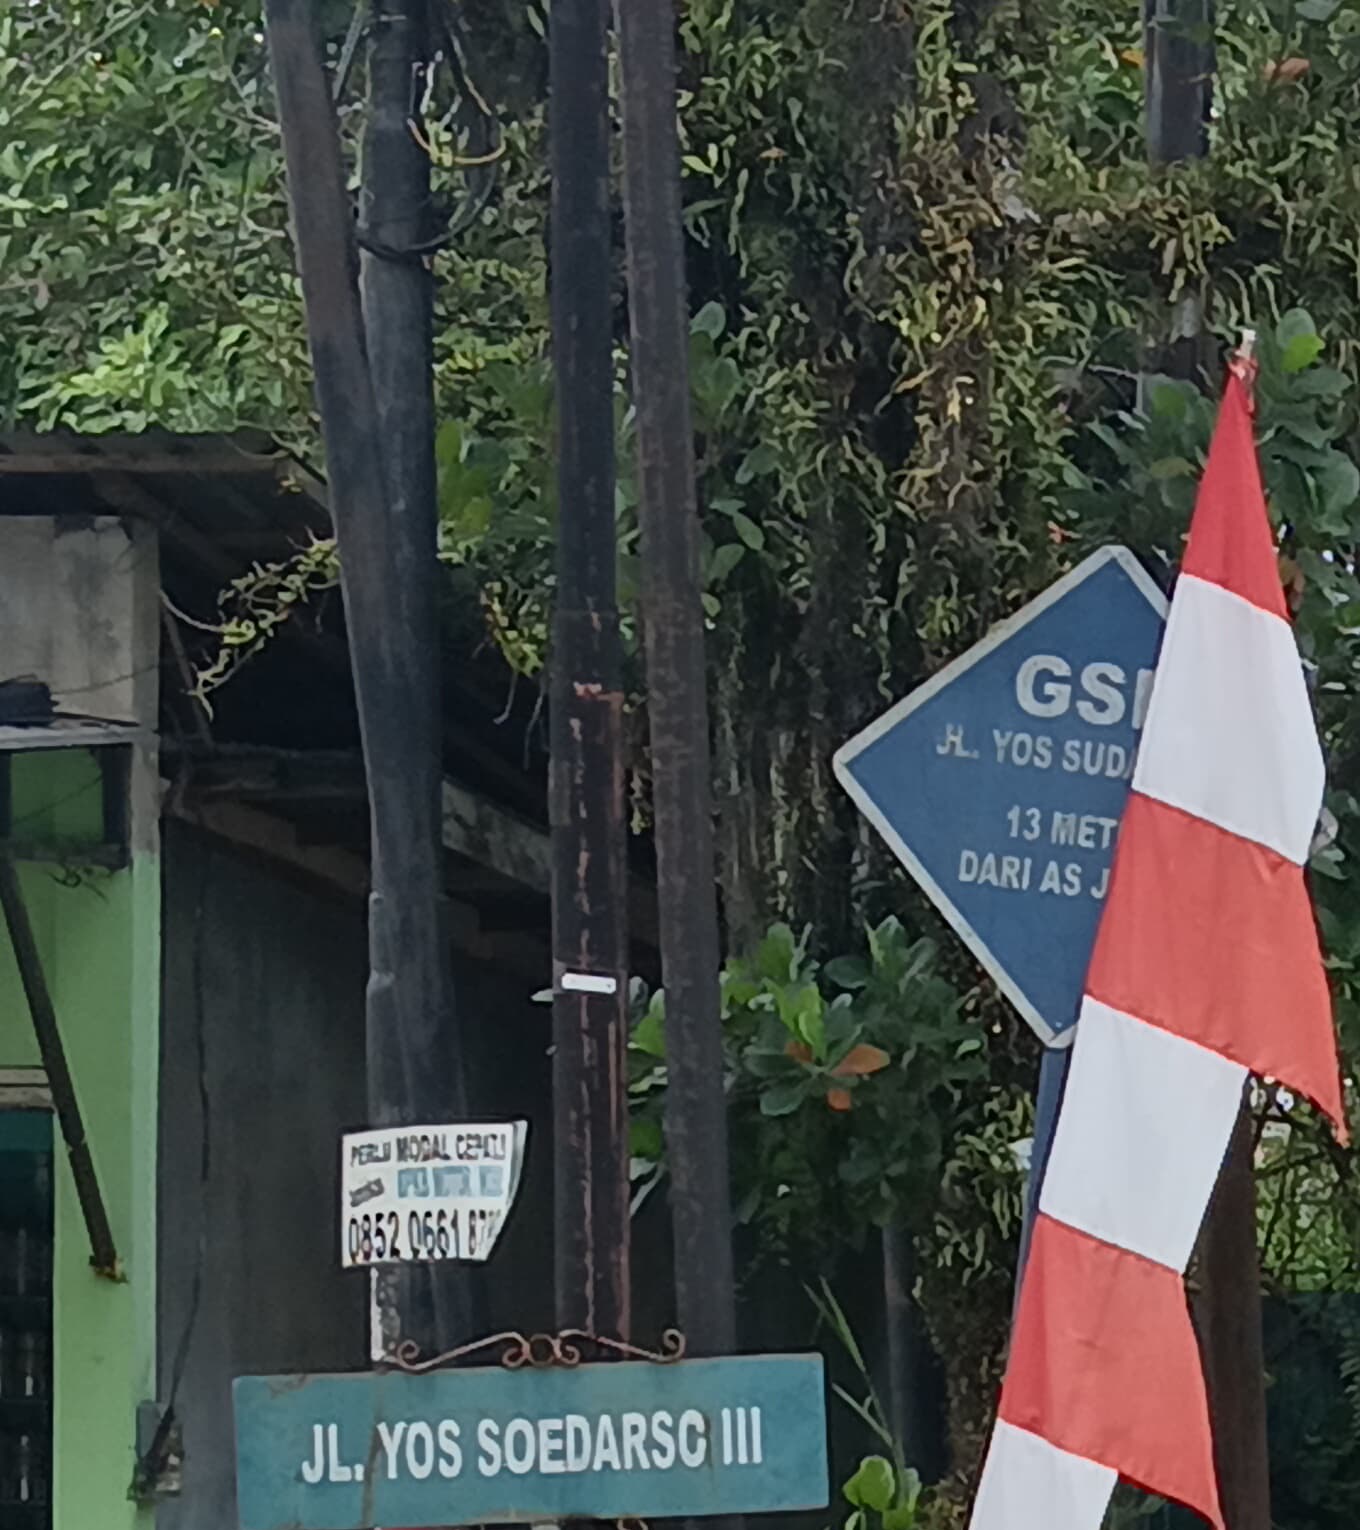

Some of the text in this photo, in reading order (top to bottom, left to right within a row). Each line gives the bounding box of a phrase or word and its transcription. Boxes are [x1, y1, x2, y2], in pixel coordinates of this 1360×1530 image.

[992, 728, 1054, 769] YOS
[1062, 739, 1132, 780] SUD
[1006, 804, 1123, 849] 13 MET
[957, 849, 1032, 891] DARI
[1039, 860, 1083, 897] AS
[349, 1210, 401, 1263] 0852
[408, 1208, 461, 1262] 0661
[301, 1423, 365, 1484] JL.
[376, 1419, 462, 1481] YOS
[720, 1405, 764, 1466] III
